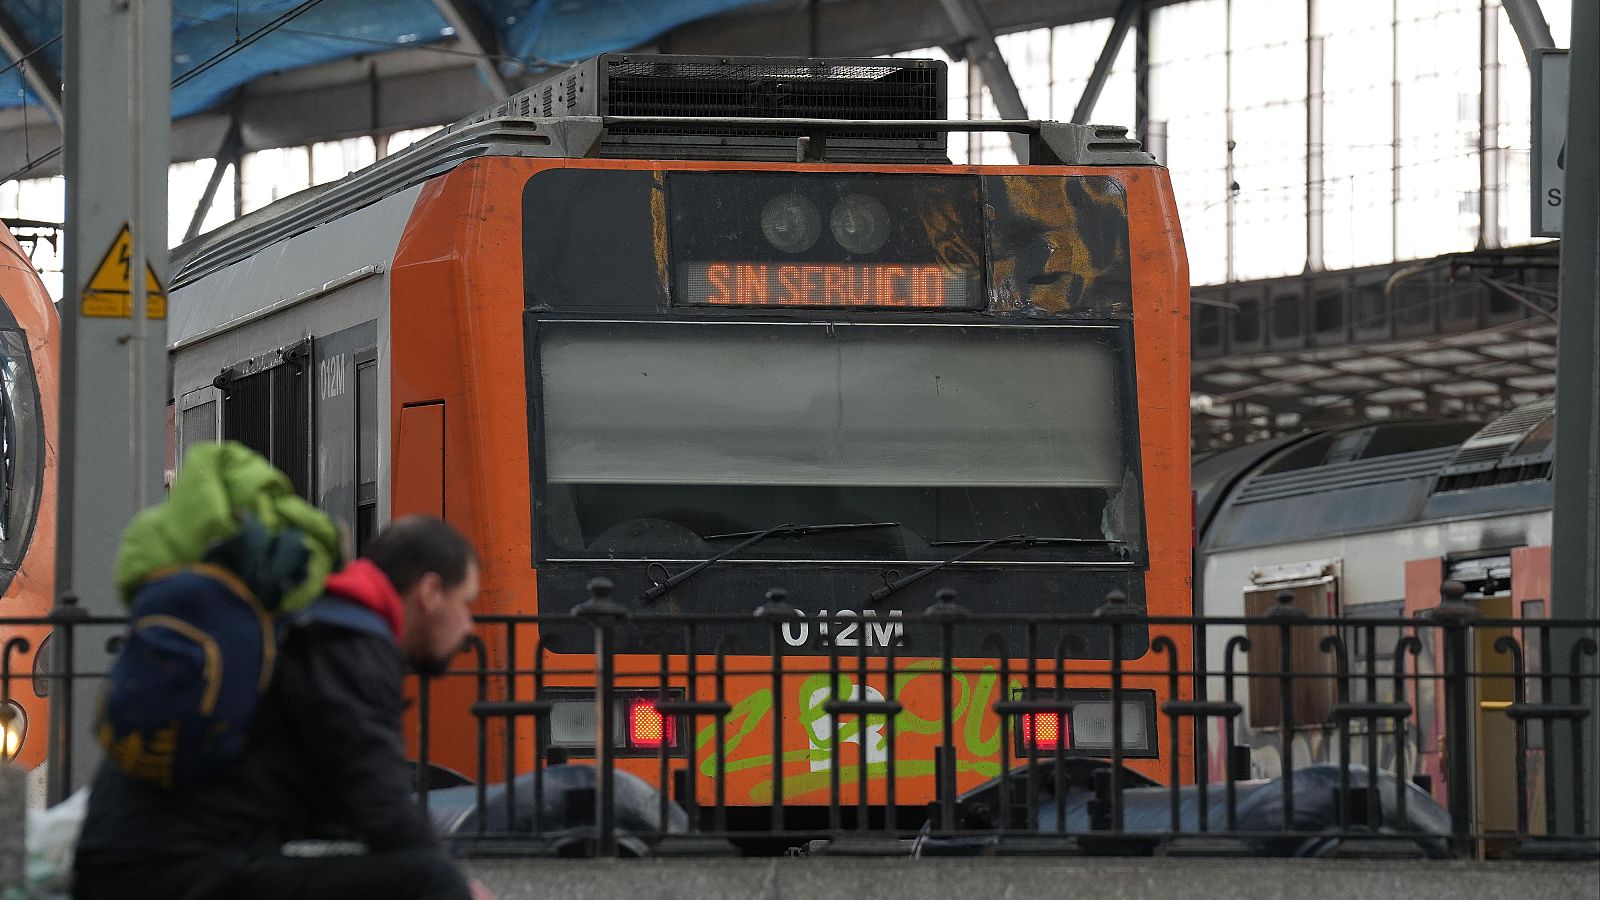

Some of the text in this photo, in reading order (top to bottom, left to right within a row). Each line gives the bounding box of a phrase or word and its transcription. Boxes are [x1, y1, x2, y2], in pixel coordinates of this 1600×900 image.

[708, 263, 768, 305] SIN
[320, 352, 345, 400] 012M
[781, 608, 904, 647] 012M
